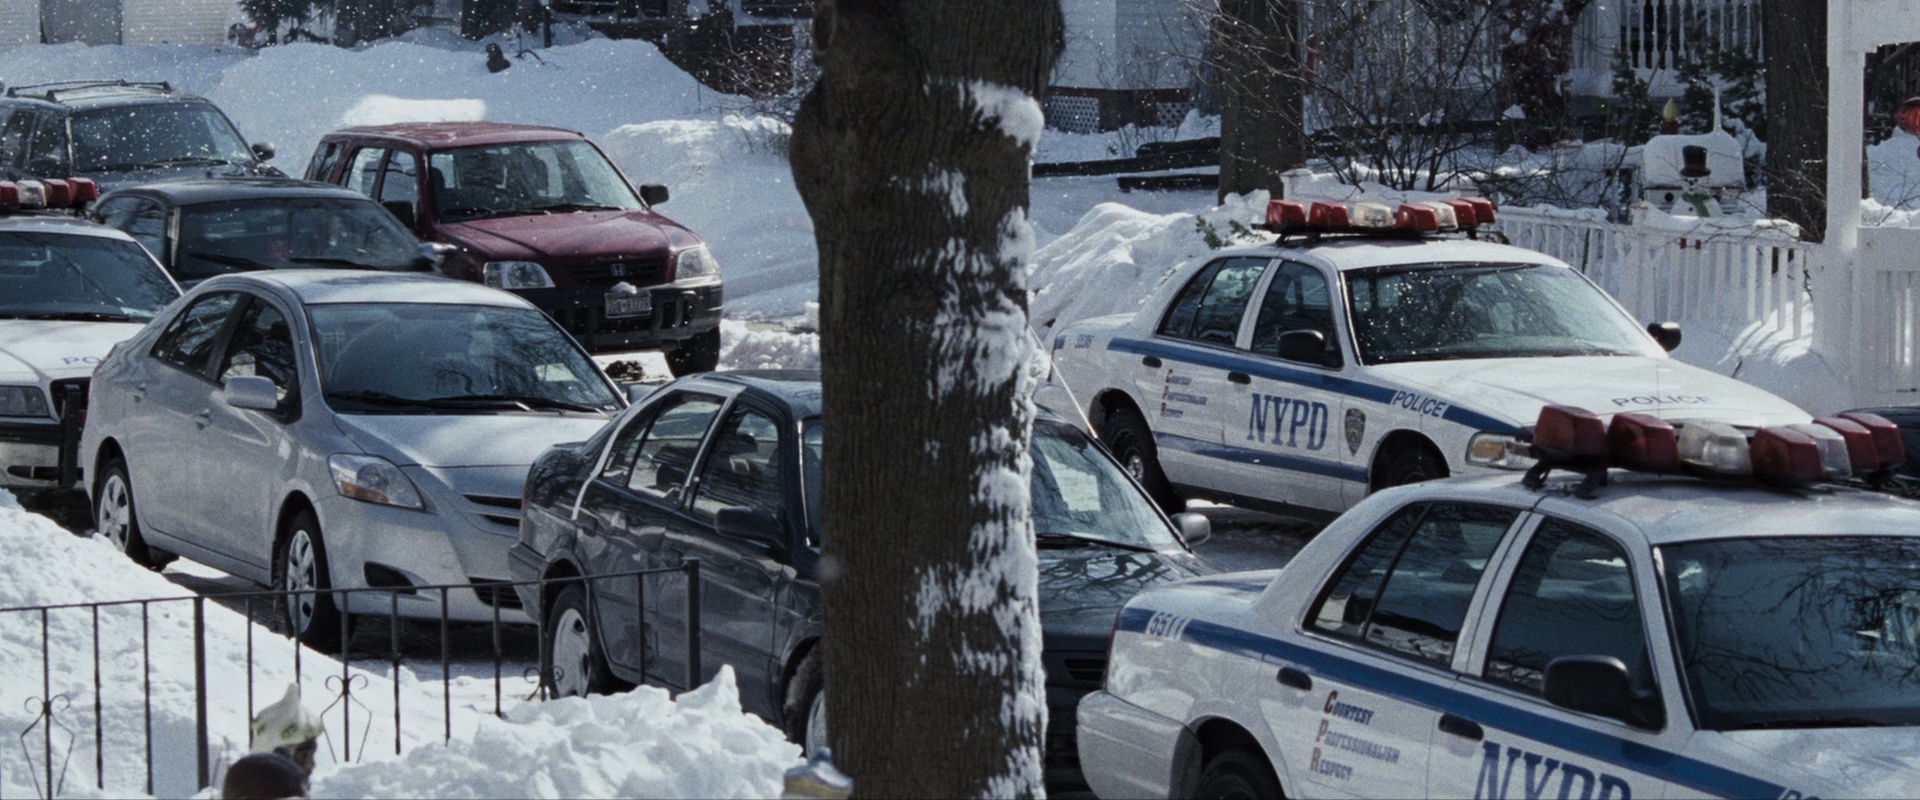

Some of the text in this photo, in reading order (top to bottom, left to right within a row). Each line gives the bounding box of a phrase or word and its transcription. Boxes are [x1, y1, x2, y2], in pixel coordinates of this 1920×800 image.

[1392, 391, 1447, 418] POLICE
[1611, 395, 1715, 407] POLICE
[1246, 392, 1329, 451] NYPD
[1323, 690, 1374, 725] COURTESY
[1315, 718, 1401, 764] PROFESSIONALISM
[1309, 746, 1354, 780] RESPECT
